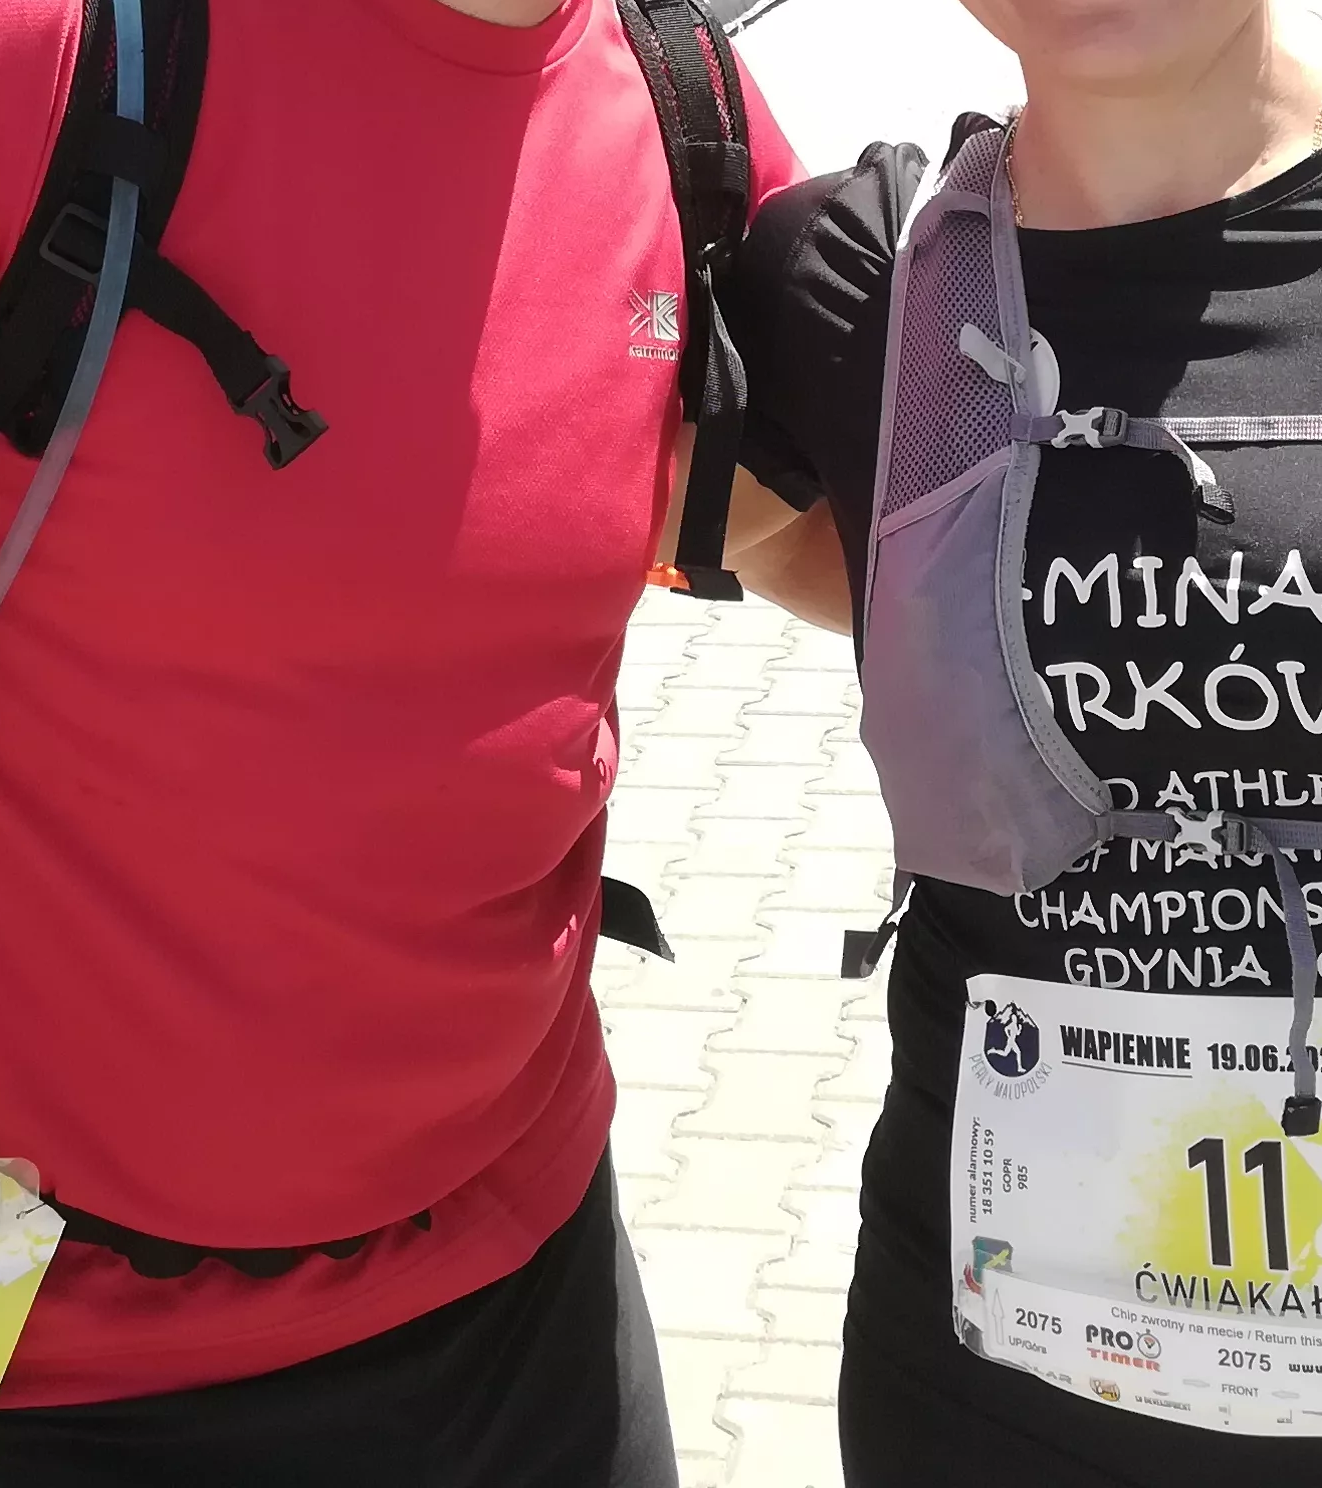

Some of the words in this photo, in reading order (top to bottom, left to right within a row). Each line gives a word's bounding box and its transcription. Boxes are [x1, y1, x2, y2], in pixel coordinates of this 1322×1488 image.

[1064, 945, 1273, 991] GDYNIA
[1059, 1024, 1192, 1070] WAPIENNE
[984, 1128, 994, 1146] 59
[982, 1170, 993, 1196] 351
[1002, 1157, 1012, 1193] GOPR
[1017, 1164, 1029, 1190] 985
[969, 1183, 977, 1224] numer
[981, 1198, 993, 1215] 18
[1186, 1137, 1290, 1272] 11
[1015, 1307, 1063, 1336] 2075
[1110, 1306, 1138, 1323] Chip
[1140, 1314, 1185, 1334] zwrotny
[1188, 1322, 1205, 1335] na
[1207, 1326, 1244, 1340] mecie
[1254, 1329, 1298, 1346] Return
[1085, 1323, 1135, 1351] PRO
[1218, 1347, 1273, 1373] 2075
[1220, 1383, 1260, 1399] FRONT
